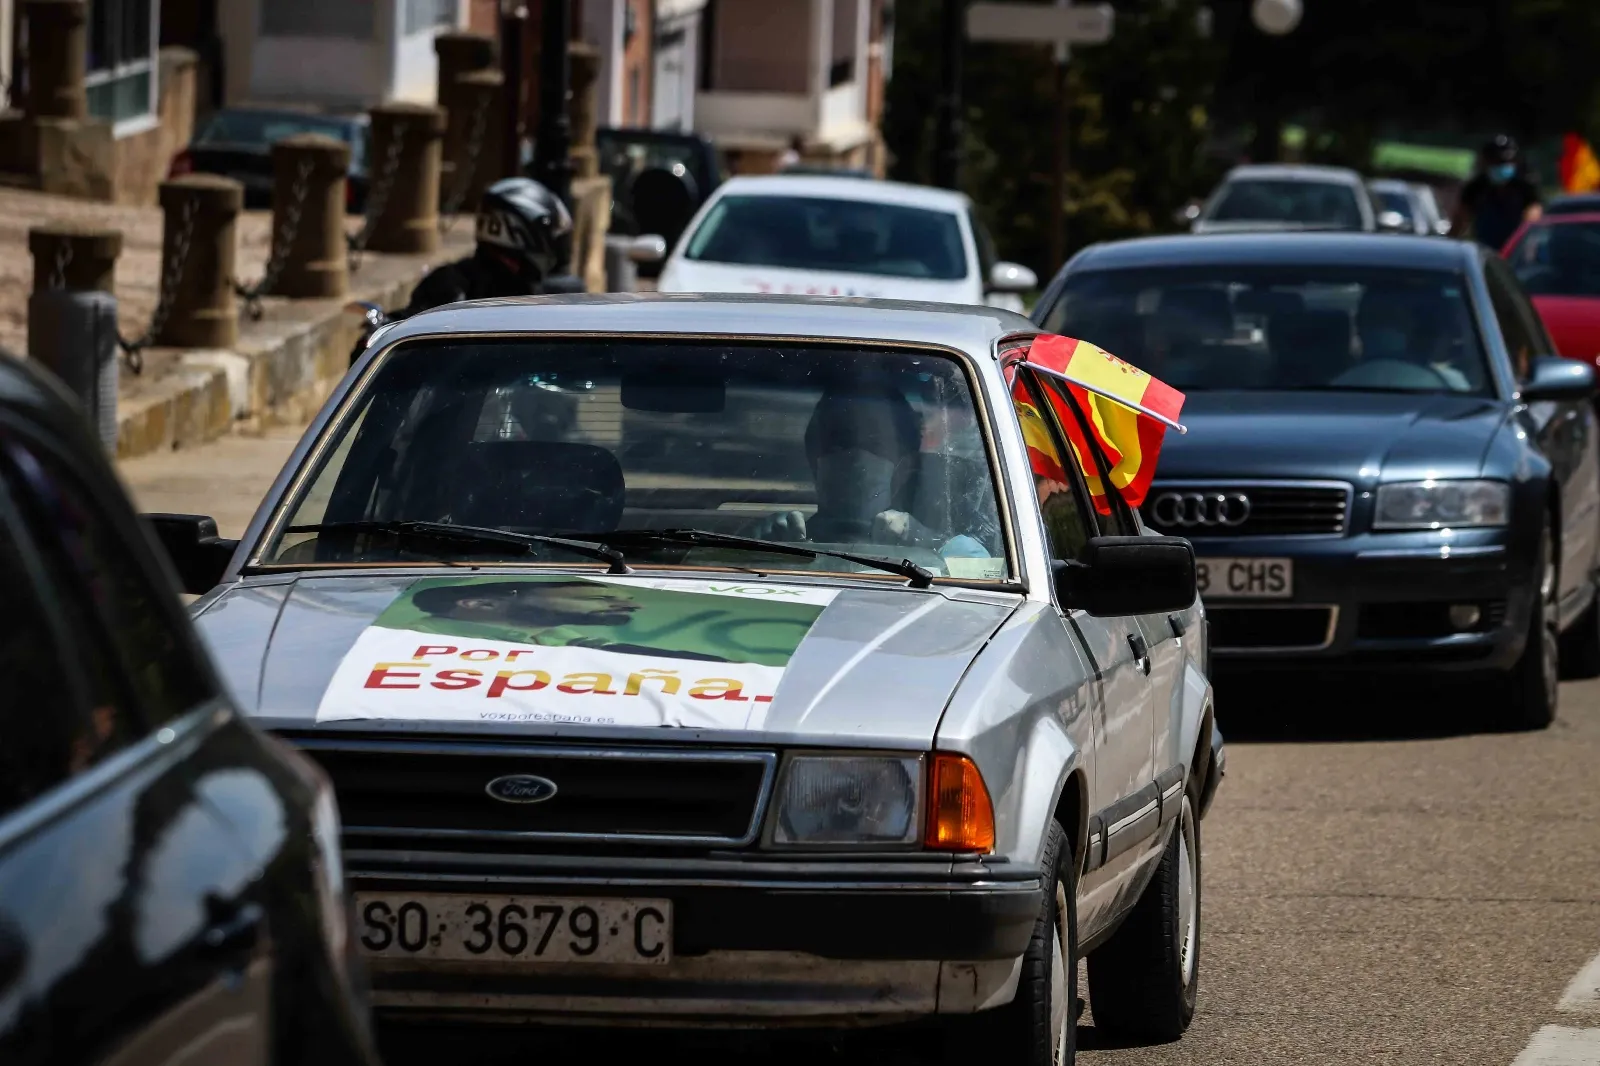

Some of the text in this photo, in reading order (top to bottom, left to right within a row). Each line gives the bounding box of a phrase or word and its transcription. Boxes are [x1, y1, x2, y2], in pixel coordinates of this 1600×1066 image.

[1227, 562, 1286, 592] CHS
[708, 585, 807, 597] VOX
[411, 644, 534, 663] Por
[363, 661, 775, 703] España.
[502, 780, 541, 797] Ford
[360, 901, 665, 958] SO 3679 C
